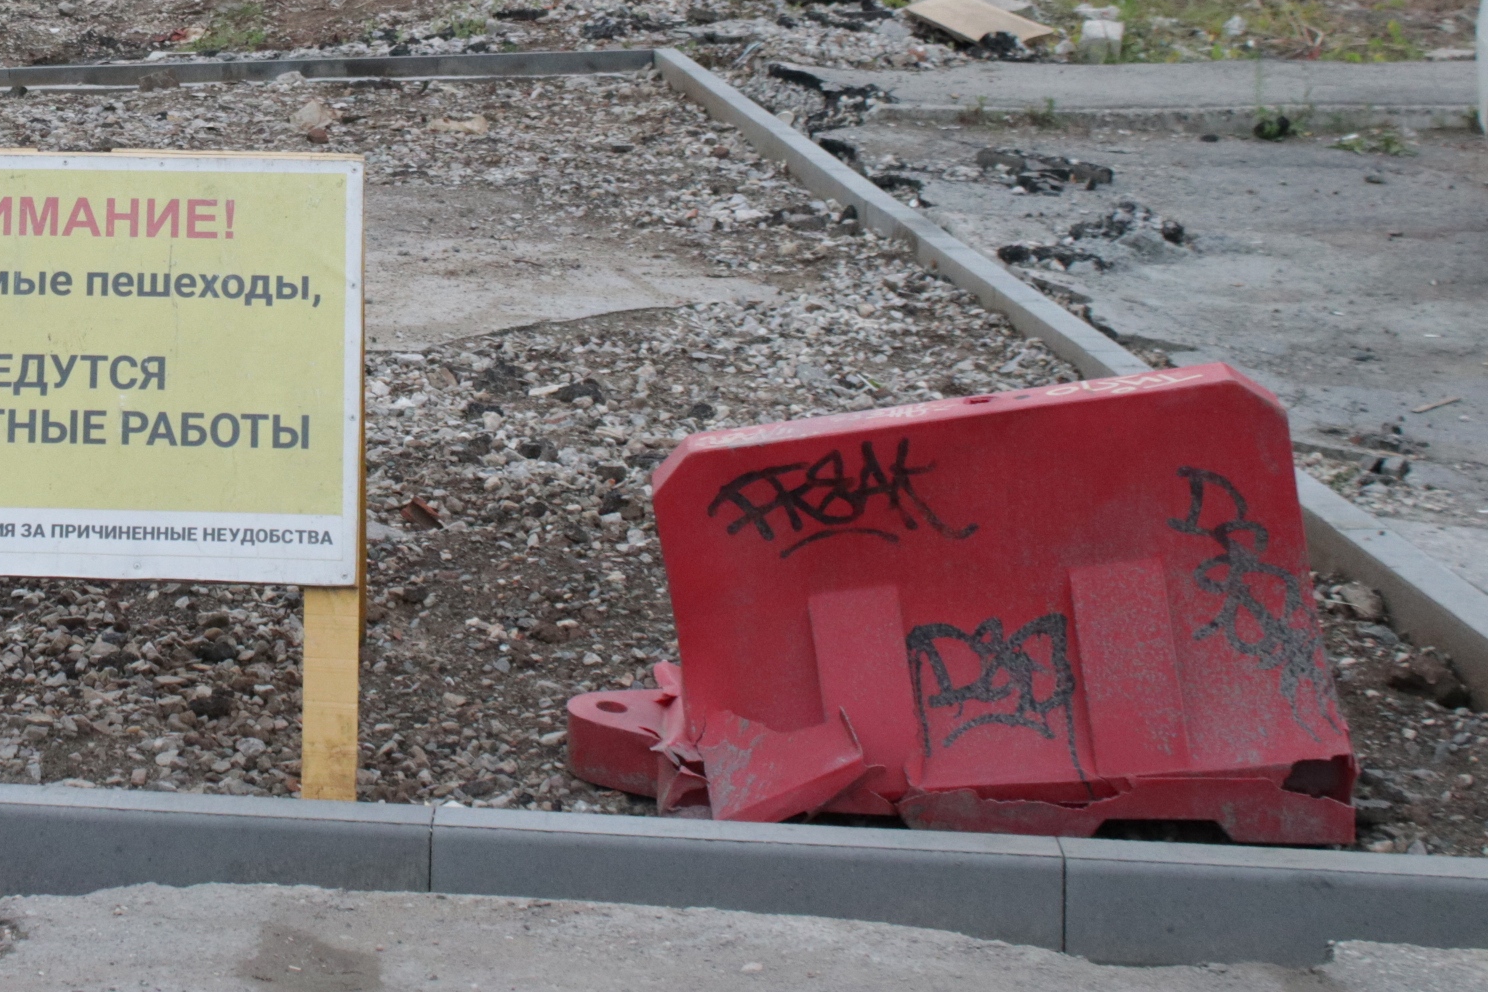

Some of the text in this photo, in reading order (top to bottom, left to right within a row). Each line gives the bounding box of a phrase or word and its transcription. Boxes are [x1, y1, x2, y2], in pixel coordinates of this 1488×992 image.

[86, 272, 322, 308] пешеходы,
[121, 410, 311, 450] РАБОТЫ
[20, 523, 46, 539] ЗА
[50, 524, 198, 542] ПРИЧИНЕННЫЕ
[202, 527, 334, 546] НЕУДОБСТВА
